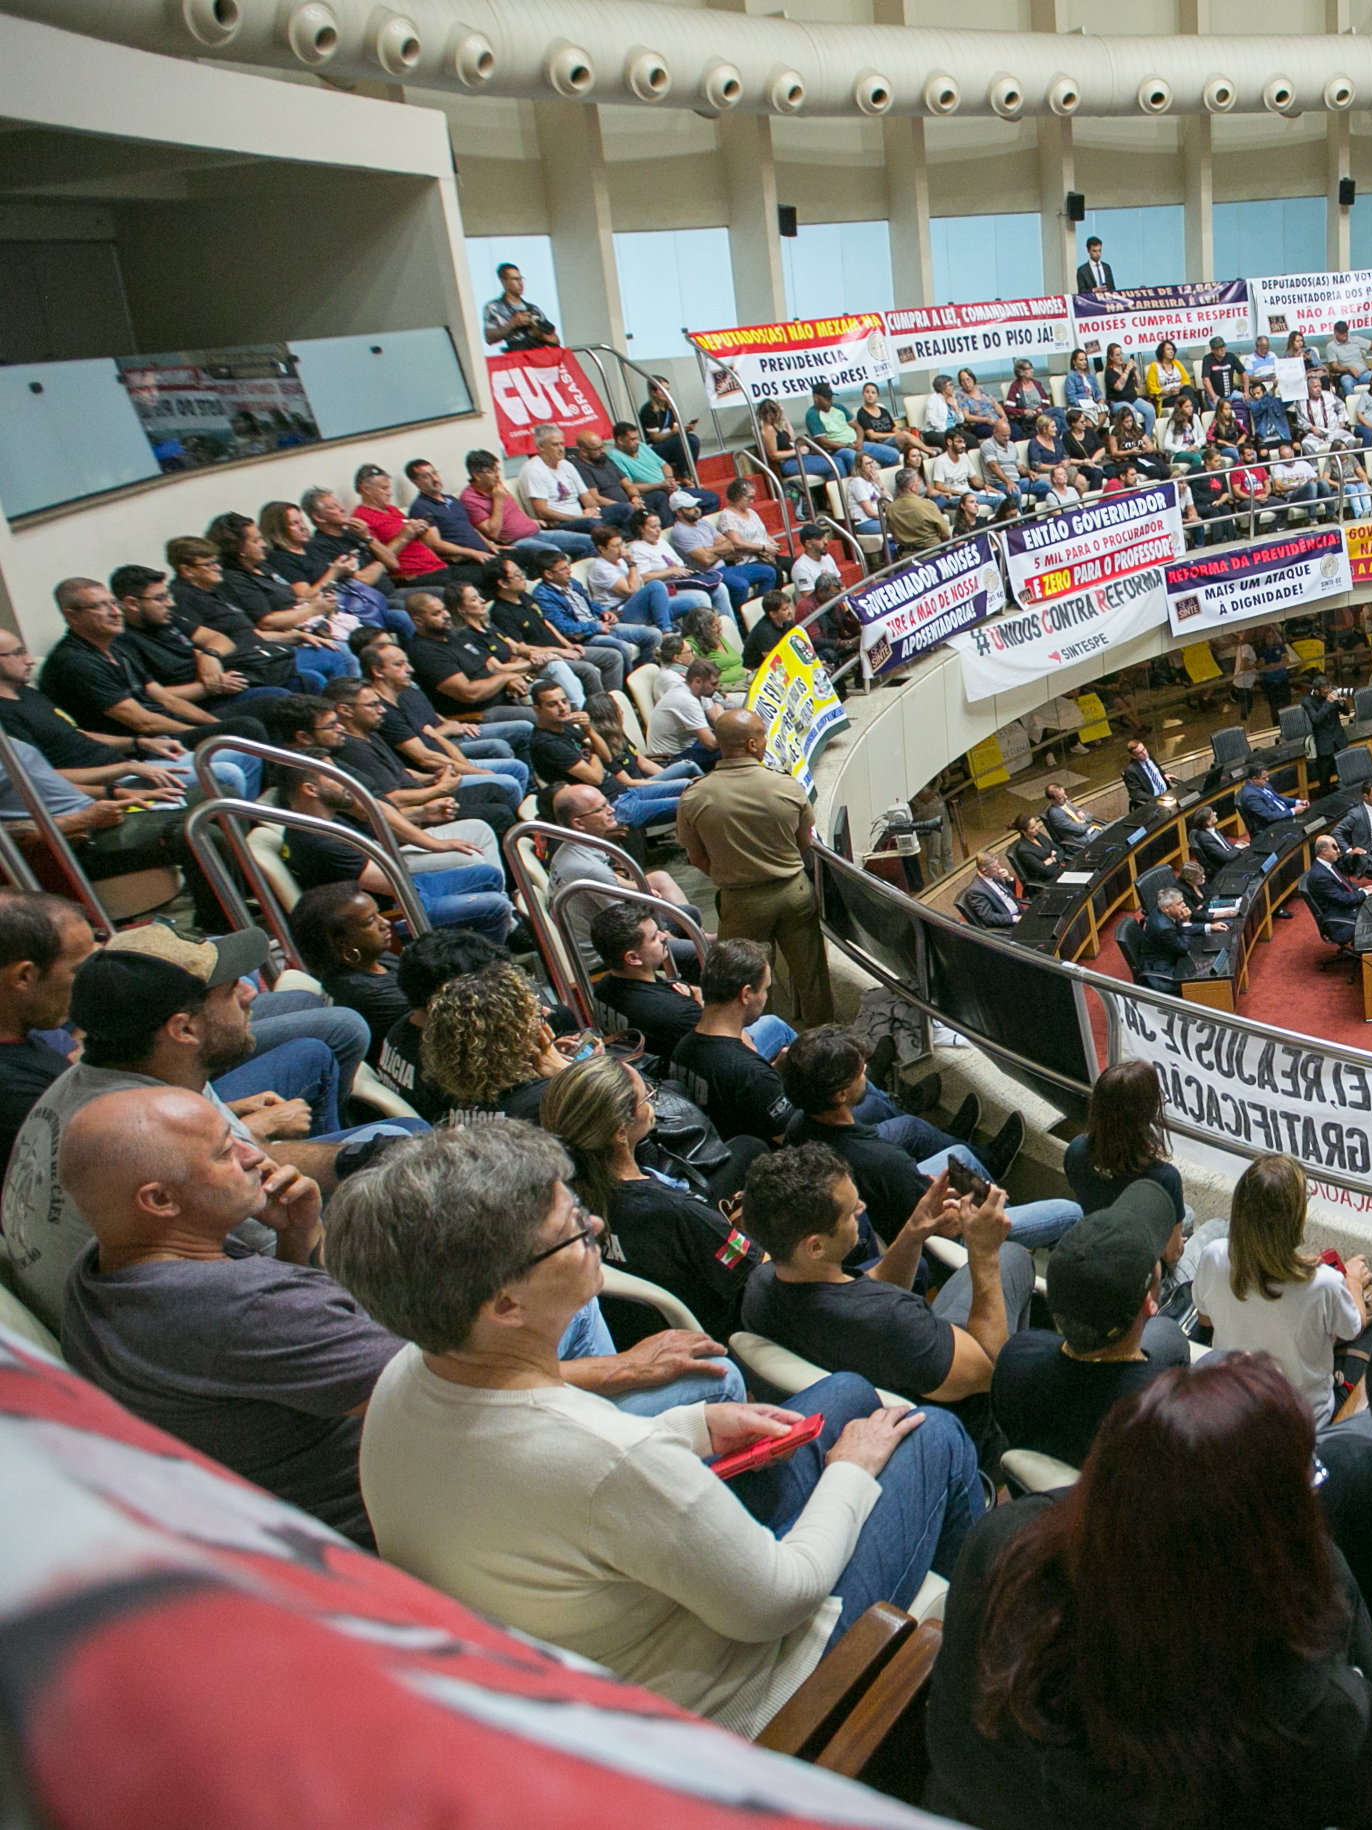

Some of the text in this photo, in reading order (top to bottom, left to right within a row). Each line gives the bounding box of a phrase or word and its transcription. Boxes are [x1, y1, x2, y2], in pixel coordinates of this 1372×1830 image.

[1156, 286, 1174, 296] DE
[1262, 275, 1330, 290] DEPUTADOS(AS)
[1270, 290, 1342, 306] APOSENTADORIA
[1344, 286, 1363, 298] DOS
[887, 295, 1067, 330] CUMPRA A LEI, COMANDANTE MOISÉS.
[1079, 306, 1249, 334] MOISÉS CUMPRA E RESPEITE
[1105, 302, 1124, 313] NA
[1127, 297, 1187, 311] CARREIRA
[1296, 305, 1322, 319] NÃO
[1327, 305, 1336, 316] A
[696, 313, 882, 352] DEPUTADOS(AS) NÃO MEXAM NA
[915, 334, 978, 358] REAJUSTE
[983, 331, 1002, 349] DO
[1006, 328, 1033, 347] PISO
[1037, 322, 1054, 343] JÁ!
[1124, 326, 1214, 345] O MAGISTÉRIO!
[1298, 322, 1316, 334] DA
[759, 350, 849, 374] PREVIDÊNCIA
[492, 366, 574, 426] CUT
[751, 381, 779, 398] DOS
[1022, 492, 1167, 550] ENTÃO GOVERNADOR
[1034, 519, 1164, 569] 5 MIL PARA O PROCURADOR
[1167, 534, 1341, 584] REFORMA DA PREVIDÊNCIA:
[858, 542, 981, 618] GOVERNADOR MOISÉS
[1032, 579, 1042, 599] E
[1042, 570, 1072, 596] ZERO
[1073, 562, 1101, 586] PARA
[1103, 557, 1113, 576] O
[1114, 536, 1174, 573] PROFESSOR?
[1204, 564, 1312, 600] MAIS UM ATAQUE
[1358, 562, 1366, 575] A
[886, 576, 979, 638] TIRE A MÃO DE NOSSA
[971, 569, 1163, 656] #UNIDOS CONTRA REFORMA
[1178, 599, 1195, 609] SEJA
[1178, 605, 1200, 619] SINTE
[1219, 582, 1304, 616] À DIGNIDADE!
[901, 600, 977, 659] APOSENTADORIA!
[871, 645, 891, 668] SINTE
[1061, 633, 1109, 660] SINTESPE
[379, 1038, 416, 1091] OLÍCIA
